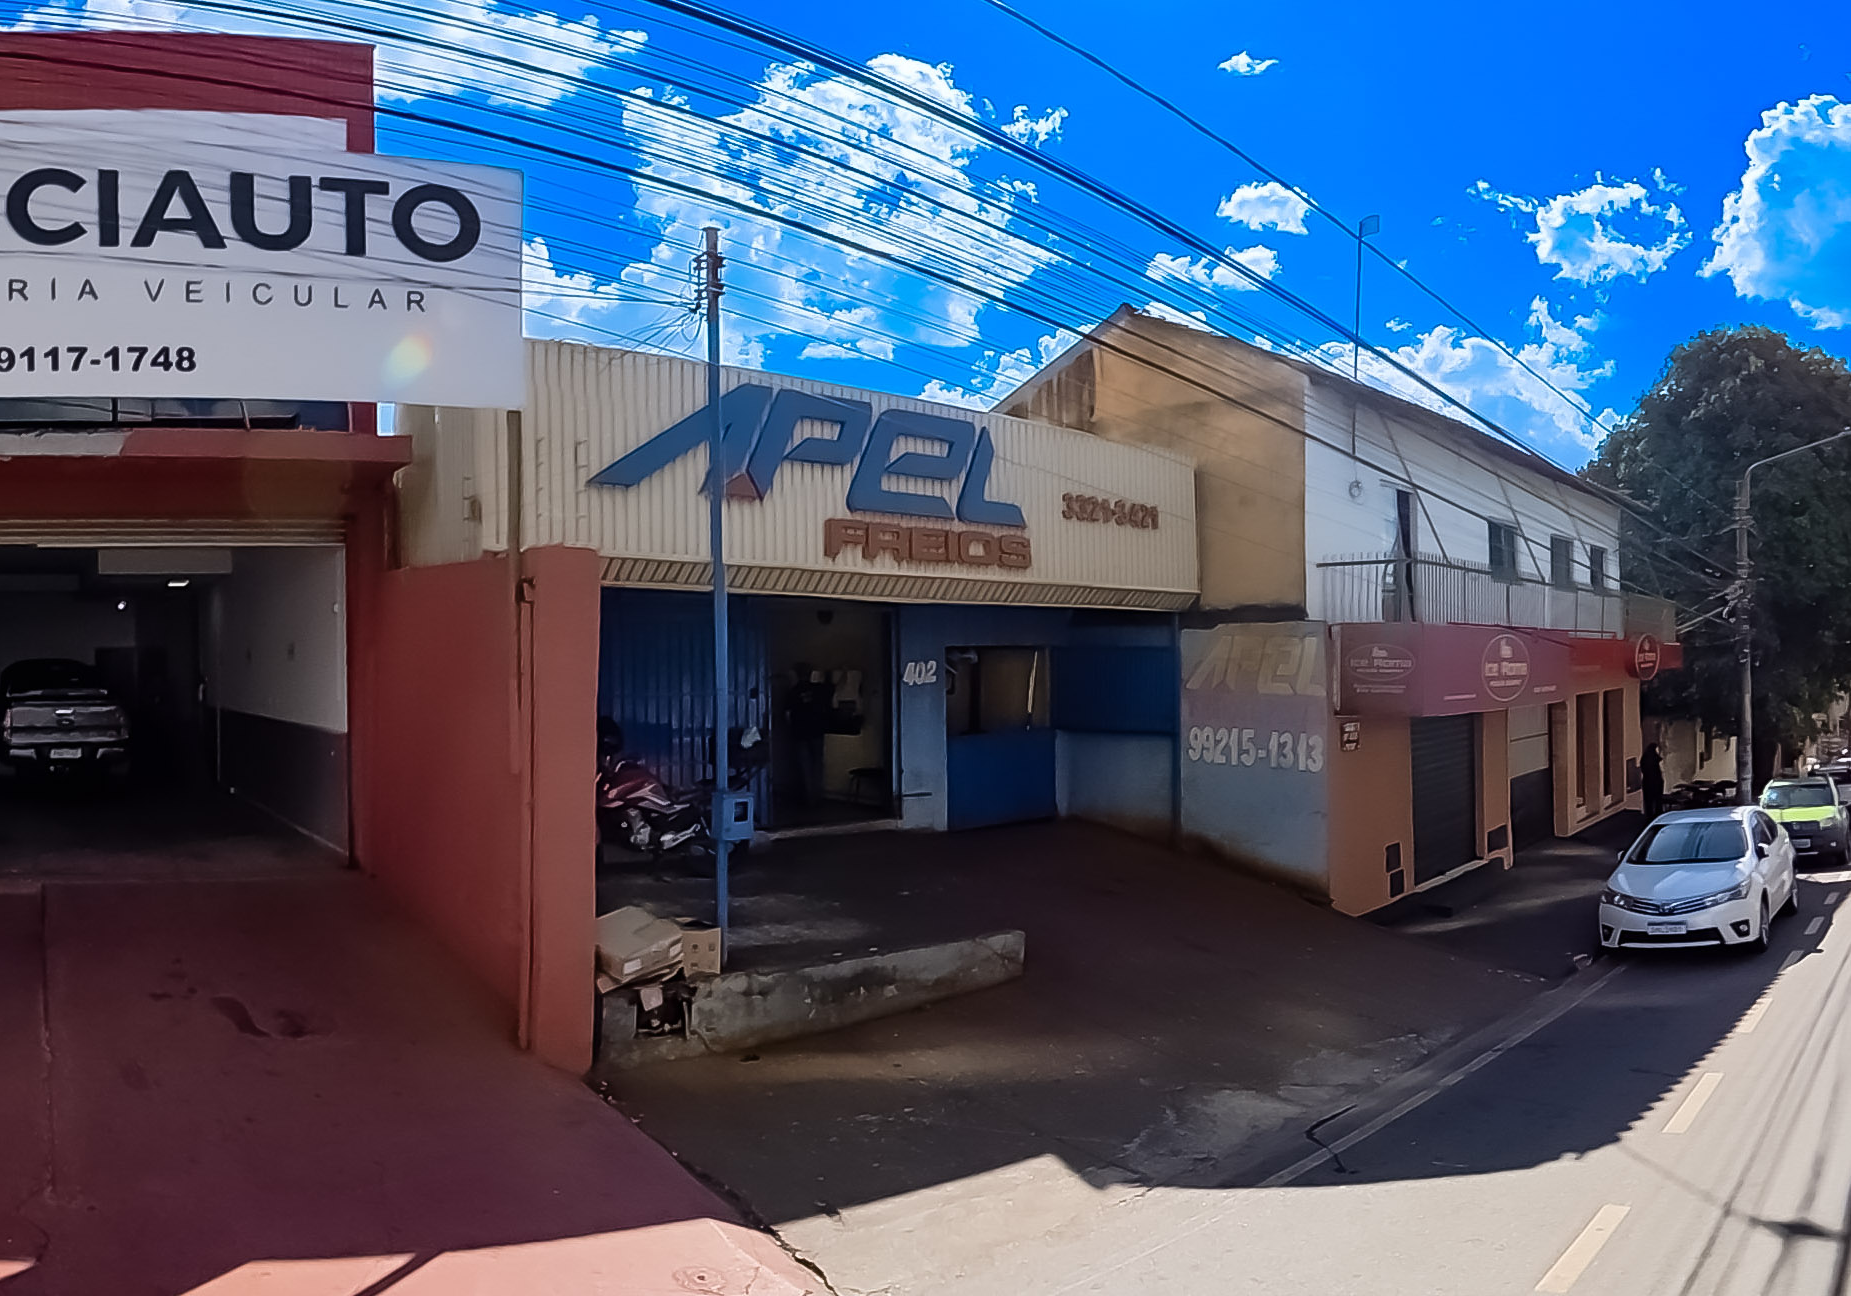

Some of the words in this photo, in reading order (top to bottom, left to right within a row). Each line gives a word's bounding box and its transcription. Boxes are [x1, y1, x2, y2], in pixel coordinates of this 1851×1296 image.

[144, 279, 425, 312] VEICULAR
[587, 383, 1027, 528] APEL
[824, 517, 1032, 570] FREIOS
[902, 660, 937, 686] 402
[1188, 726, 1324, 773] 99215-1313
